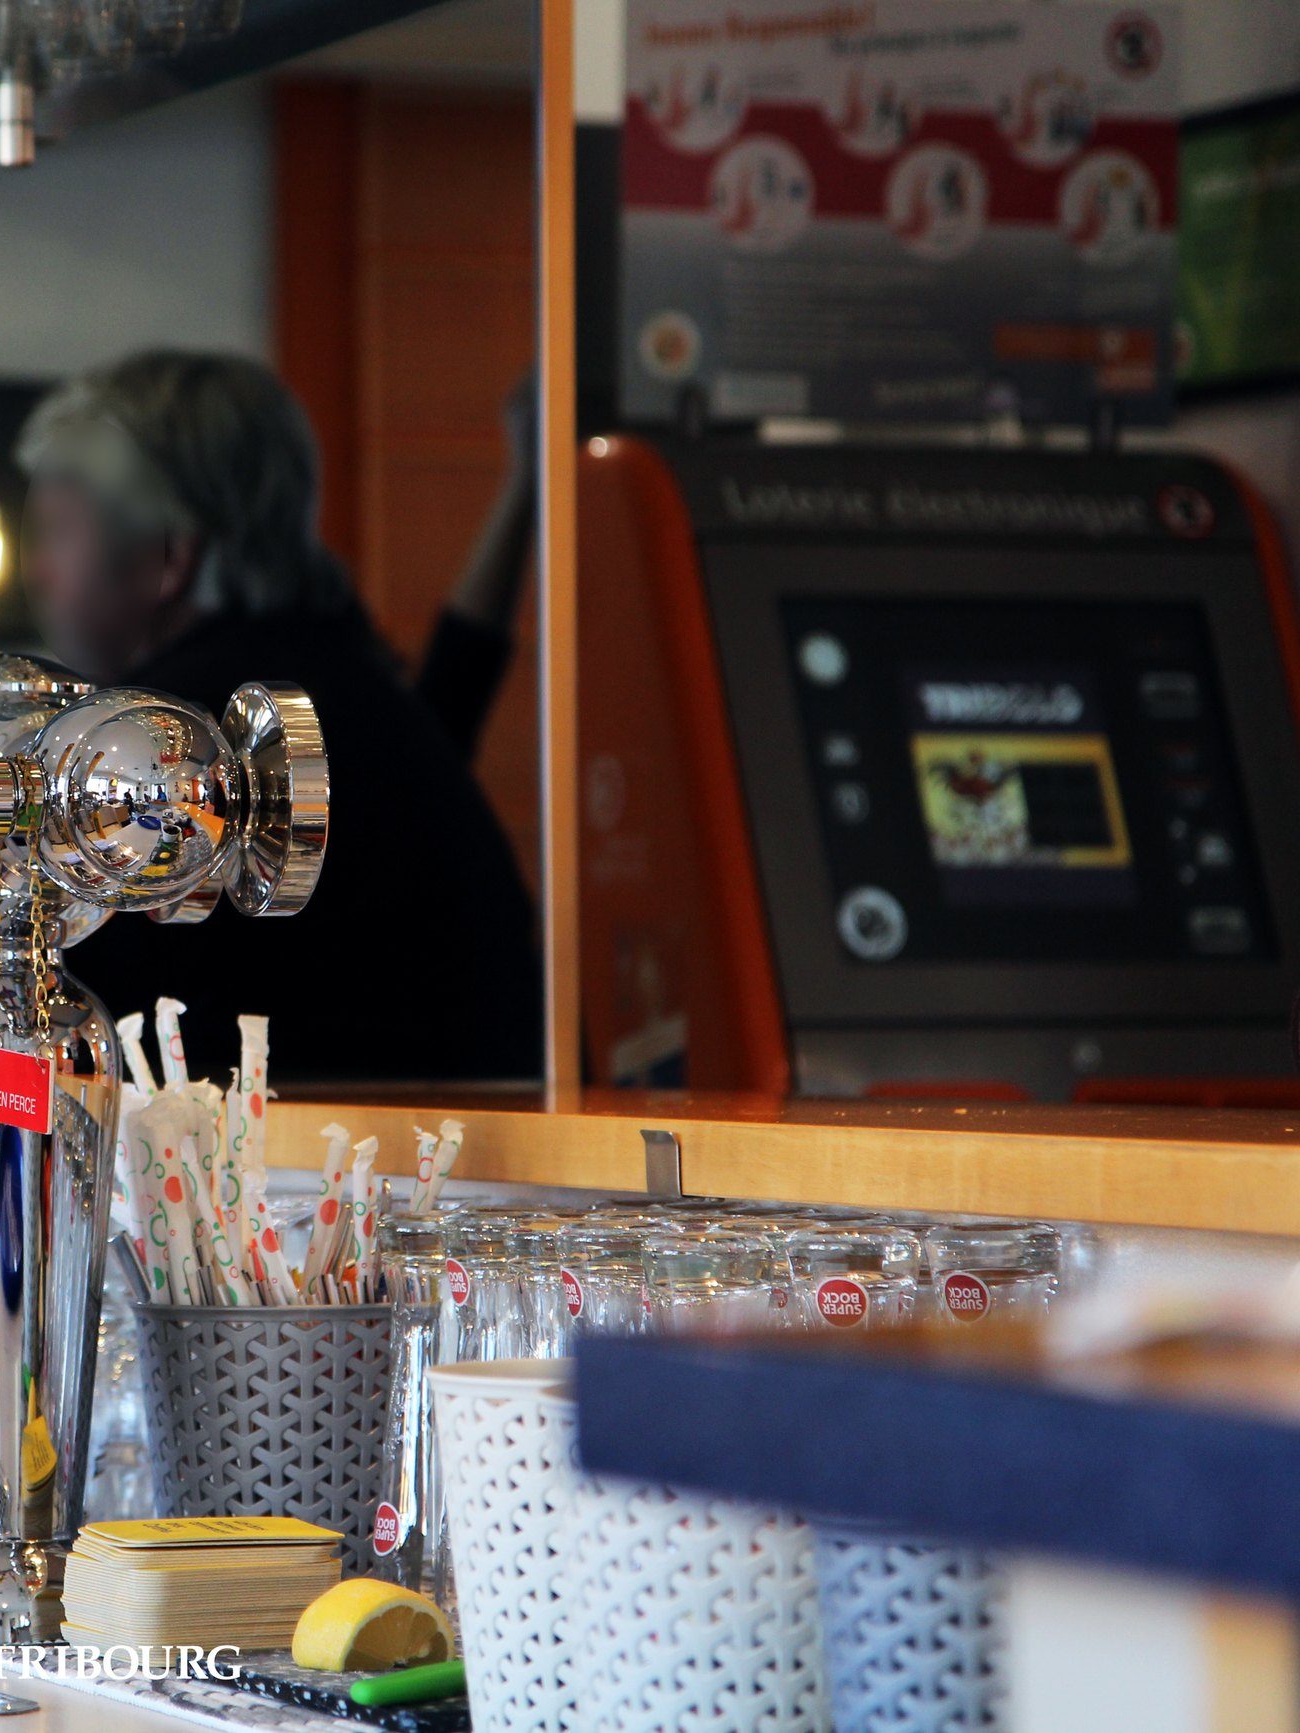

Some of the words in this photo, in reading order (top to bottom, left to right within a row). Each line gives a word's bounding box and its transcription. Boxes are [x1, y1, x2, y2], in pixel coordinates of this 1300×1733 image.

[9, 1093, 36, 1115] PERCE
[822, 1292, 860, 1304] BOCK
[949, 1286, 981, 1299] BOCK
[822, 1303, 862, 1315] SUPER
[949, 1298, 984, 1311] SUPER
